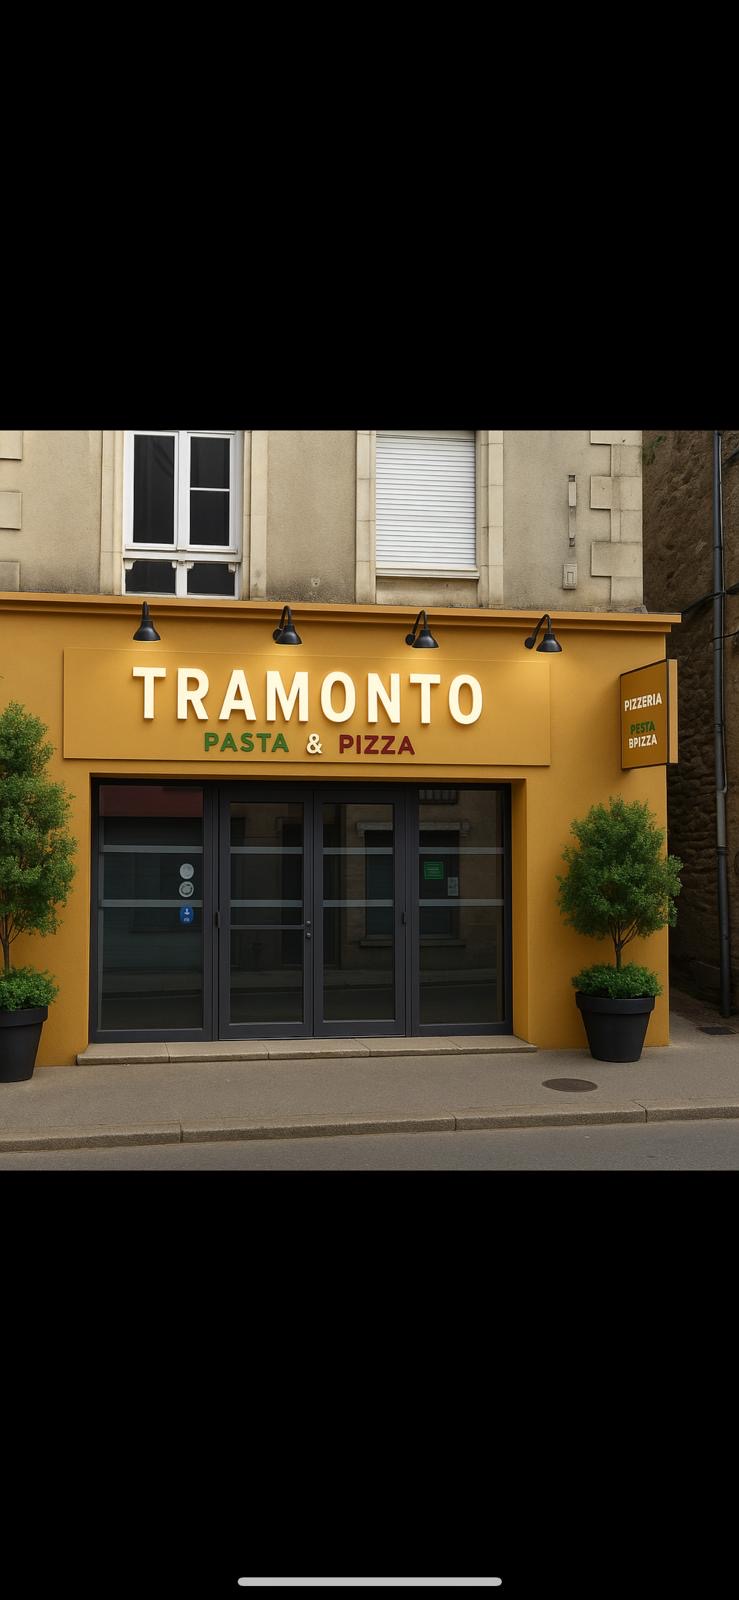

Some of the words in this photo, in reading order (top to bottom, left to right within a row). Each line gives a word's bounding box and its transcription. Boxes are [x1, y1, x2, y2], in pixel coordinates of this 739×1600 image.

[132, 666, 483, 725] TRAMONTO
[624, 692, 662, 711] PIZZERIA
[204, 732, 289, 753] PASTA
[306, 733, 323, 755] &
[339, 734, 416, 755] PIZZA
